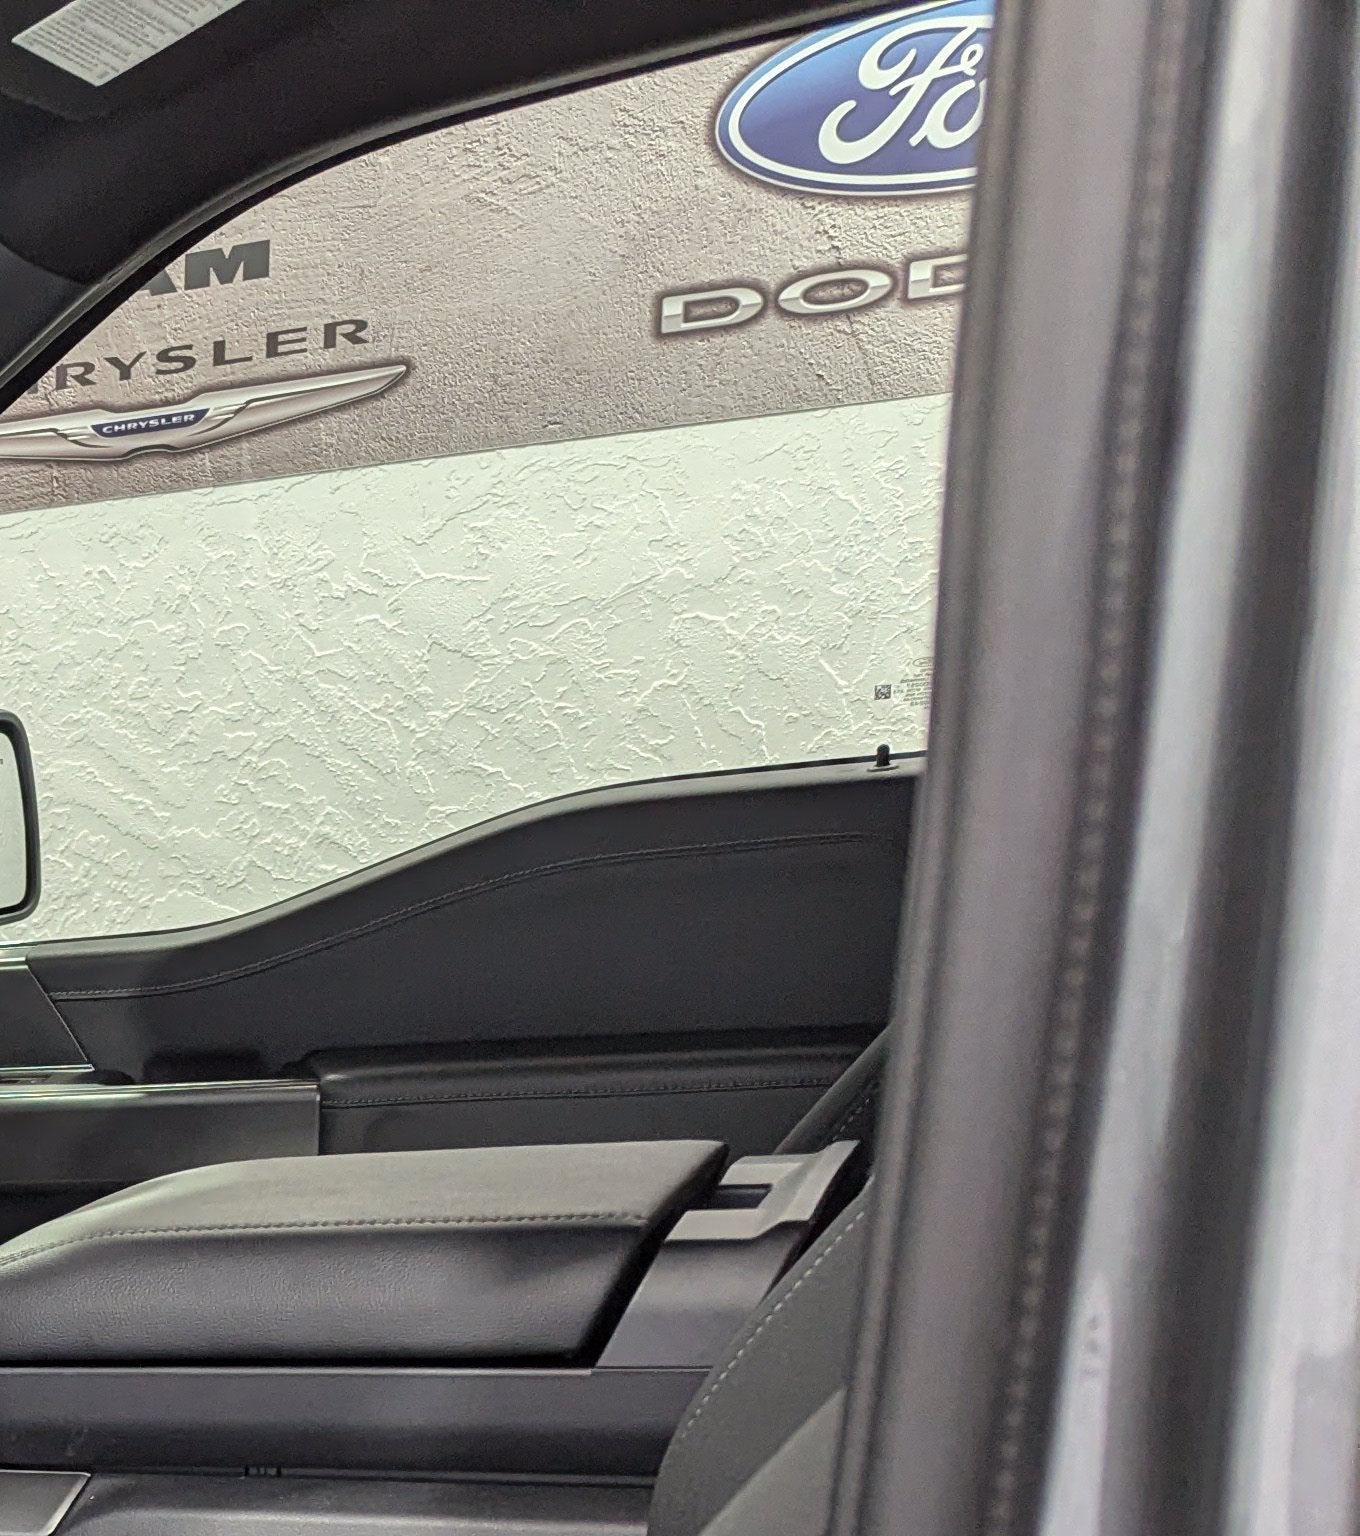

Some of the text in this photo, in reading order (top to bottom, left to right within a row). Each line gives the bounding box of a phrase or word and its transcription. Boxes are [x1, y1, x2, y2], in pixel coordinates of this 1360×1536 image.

[818, 15, 993, 165] Fo
[138, 240, 271, 297] AM
[661, 254, 968, 335] DOD
[27, 318, 371, 396] RYSLER
[101, 412, 197, 435] CHRYSLER
